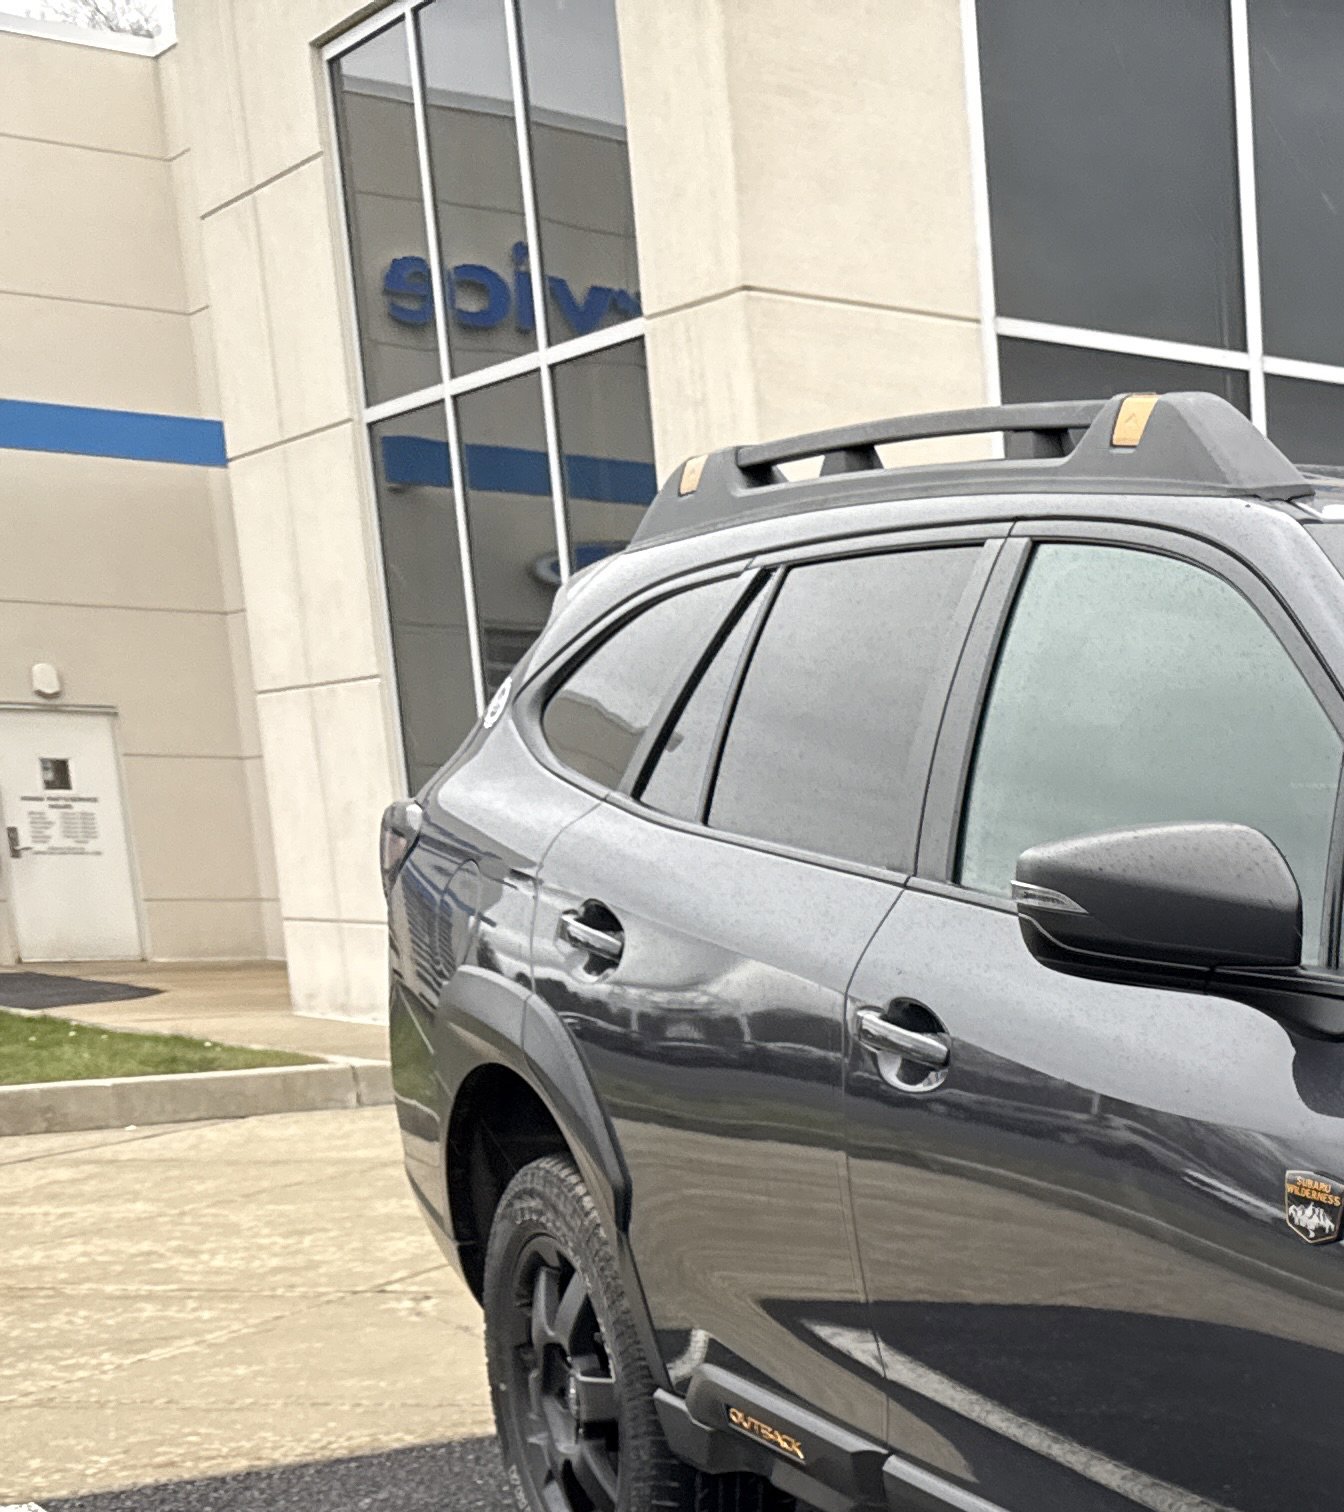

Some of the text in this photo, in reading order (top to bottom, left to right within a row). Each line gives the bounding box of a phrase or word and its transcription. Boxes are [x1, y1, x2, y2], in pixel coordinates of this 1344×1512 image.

[1287, 1183, 1342, 1207] WILDERNESS
[1296, 1175, 1332, 1193] SUBARU
[729, 1407, 805, 1460] OUTBACK
